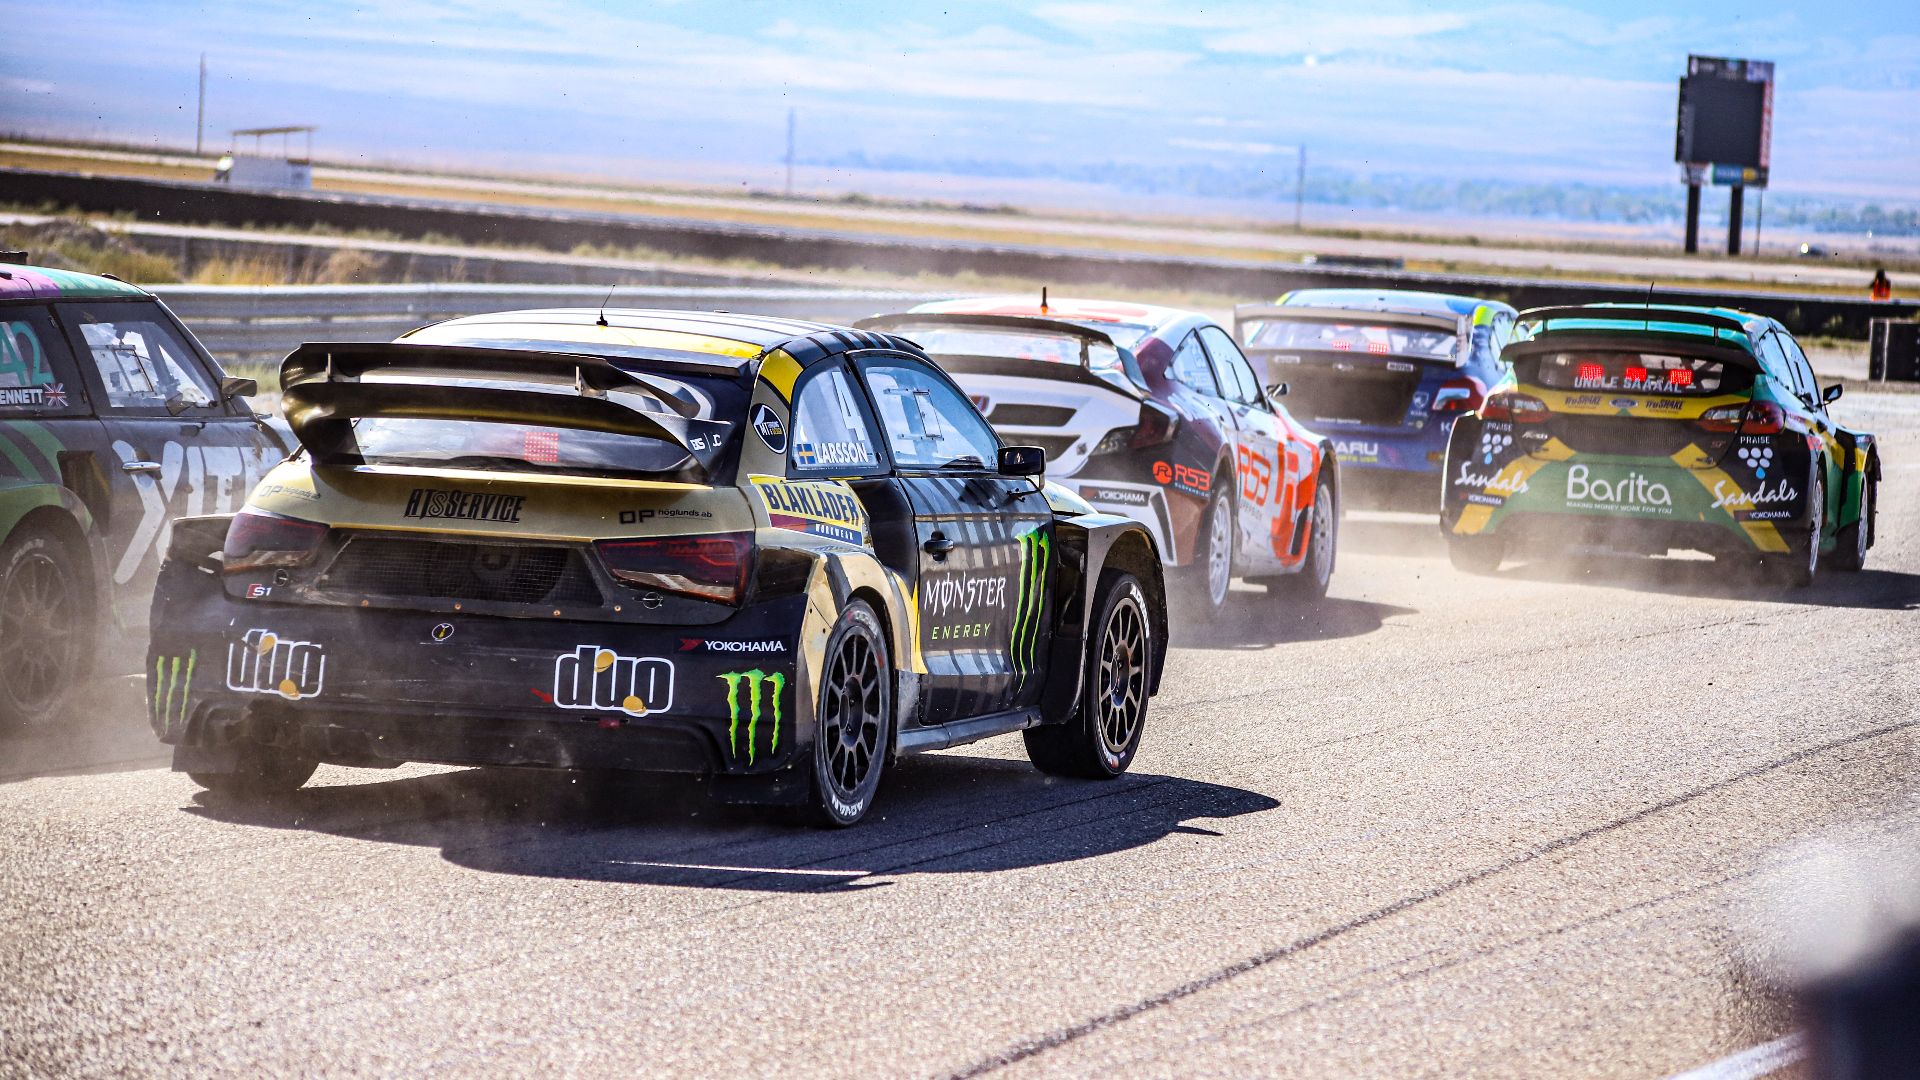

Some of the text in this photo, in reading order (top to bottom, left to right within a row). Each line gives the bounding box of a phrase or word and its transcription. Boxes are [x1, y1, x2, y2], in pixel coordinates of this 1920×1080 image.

[0, 321, 56, 386] 42
[832, 371, 866, 440] 4
[1487, 422, 1512, 431] PRAISE
[1740, 436, 1770, 444] PRAISE
[814, 442, 869, 463] LARSSON
[1454, 461, 1530, 493] Sandals
[1566, 464, 1672, 505] Barita
[1098, 490, 1145, 502] YOKOHAMA
[1710, 479, 1798, 509] Sandals
[1658, 507, 1672, 515] YOU
[1749, 510, 1791, 519] YOKOHAMA
[815, 524, 854, 540] WORKWEAR
[253, 586, 272, 597] S1
[931, 623, 991, 640] ENERGY
[705, 640, 784, 652] YOKOHAMA
